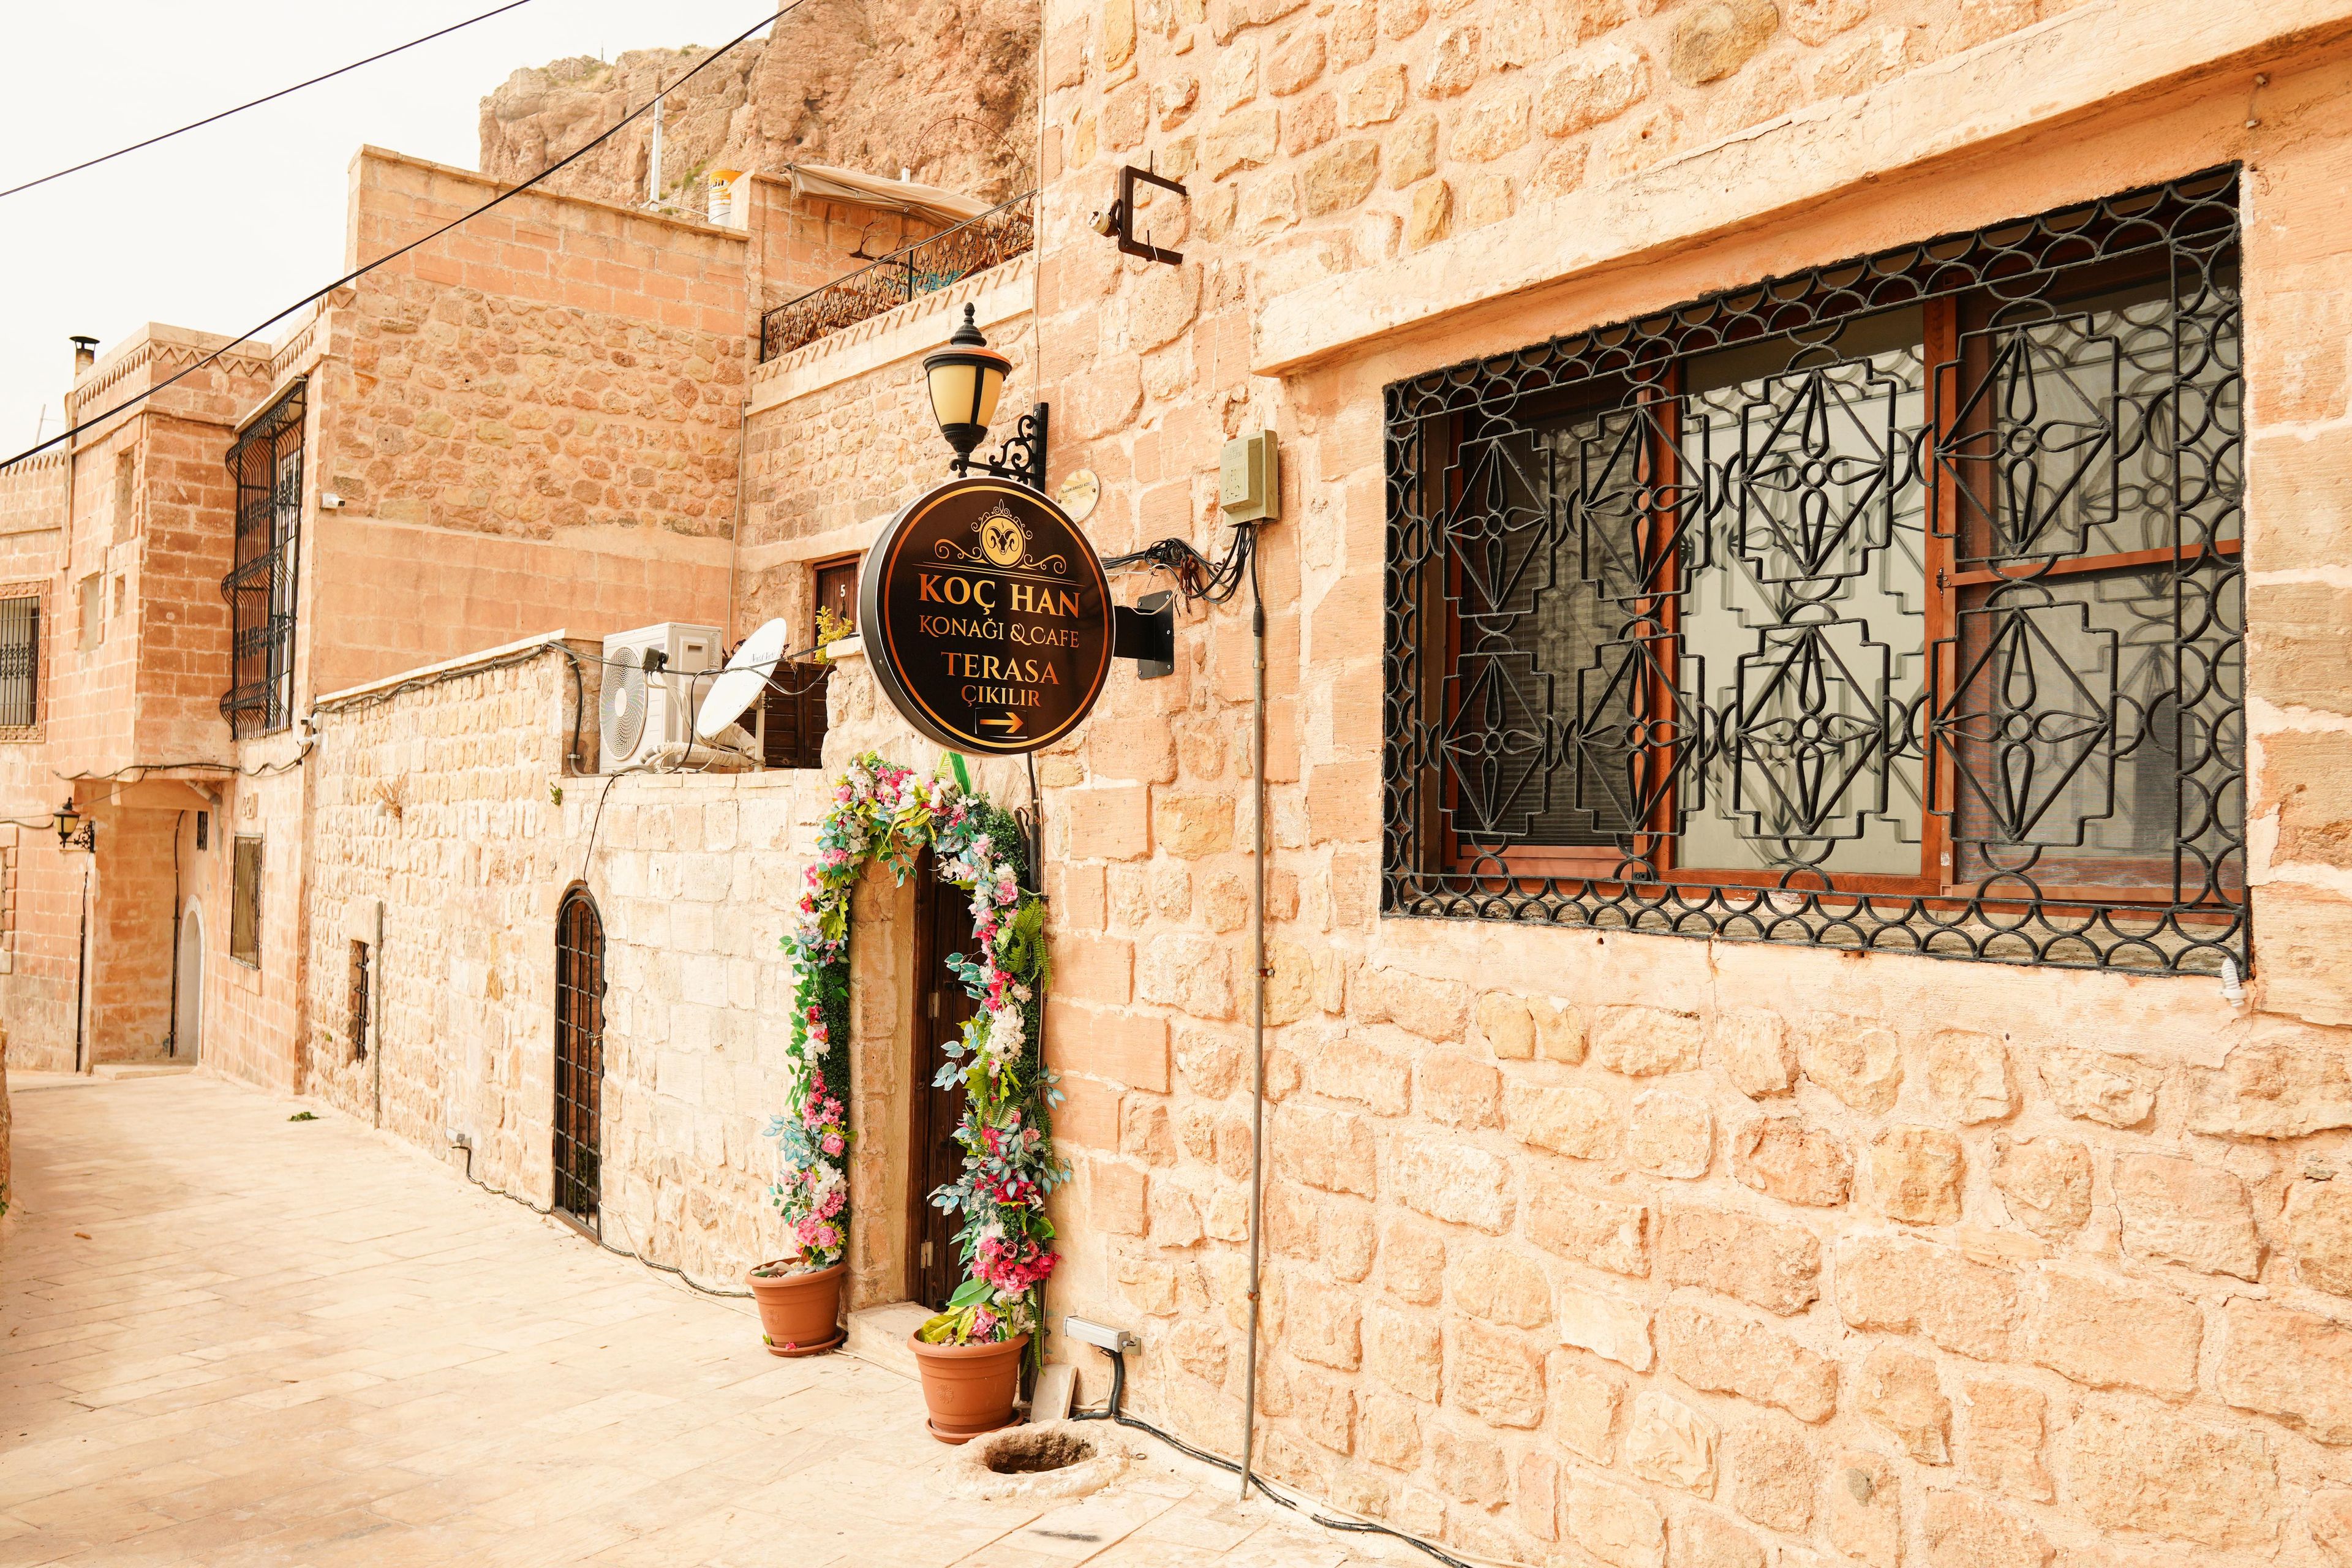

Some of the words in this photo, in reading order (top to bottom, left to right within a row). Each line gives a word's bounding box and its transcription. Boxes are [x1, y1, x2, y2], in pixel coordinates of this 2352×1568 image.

[840, 584, 846, 598] 5
[918, 573, 995, 616] KOÇ
[1009, 583, 1081, 619] HAN
[919, 614, 1005, 641] KONAĞI
[941, 651, 1060, 685] TERASA
[961, 685, 1042, 707] ÇIKILIR
